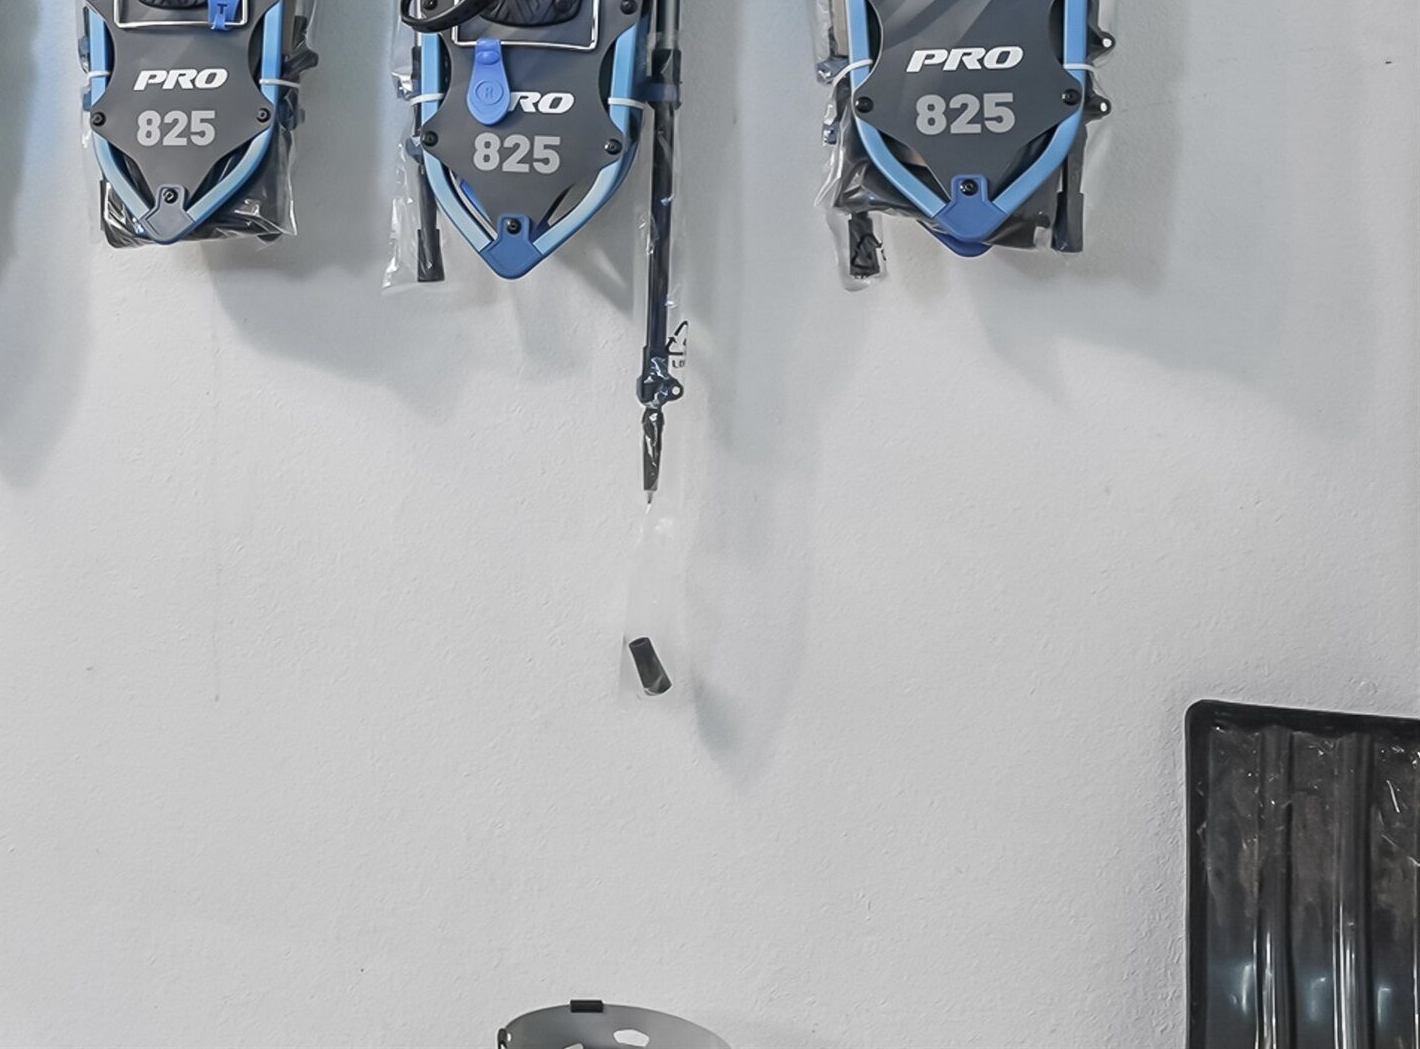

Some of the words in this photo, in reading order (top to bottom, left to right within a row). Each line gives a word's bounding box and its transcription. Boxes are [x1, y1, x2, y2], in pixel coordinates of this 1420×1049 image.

[906, 46, 1024, 73] PRO
[133, 68, 228, 91] PRO
[508, 91, 575, 114] RO
[916, 92, 1016, 136] 825
[137, 110, 216, 147] 825
[473, 132, 561, 174] 825
